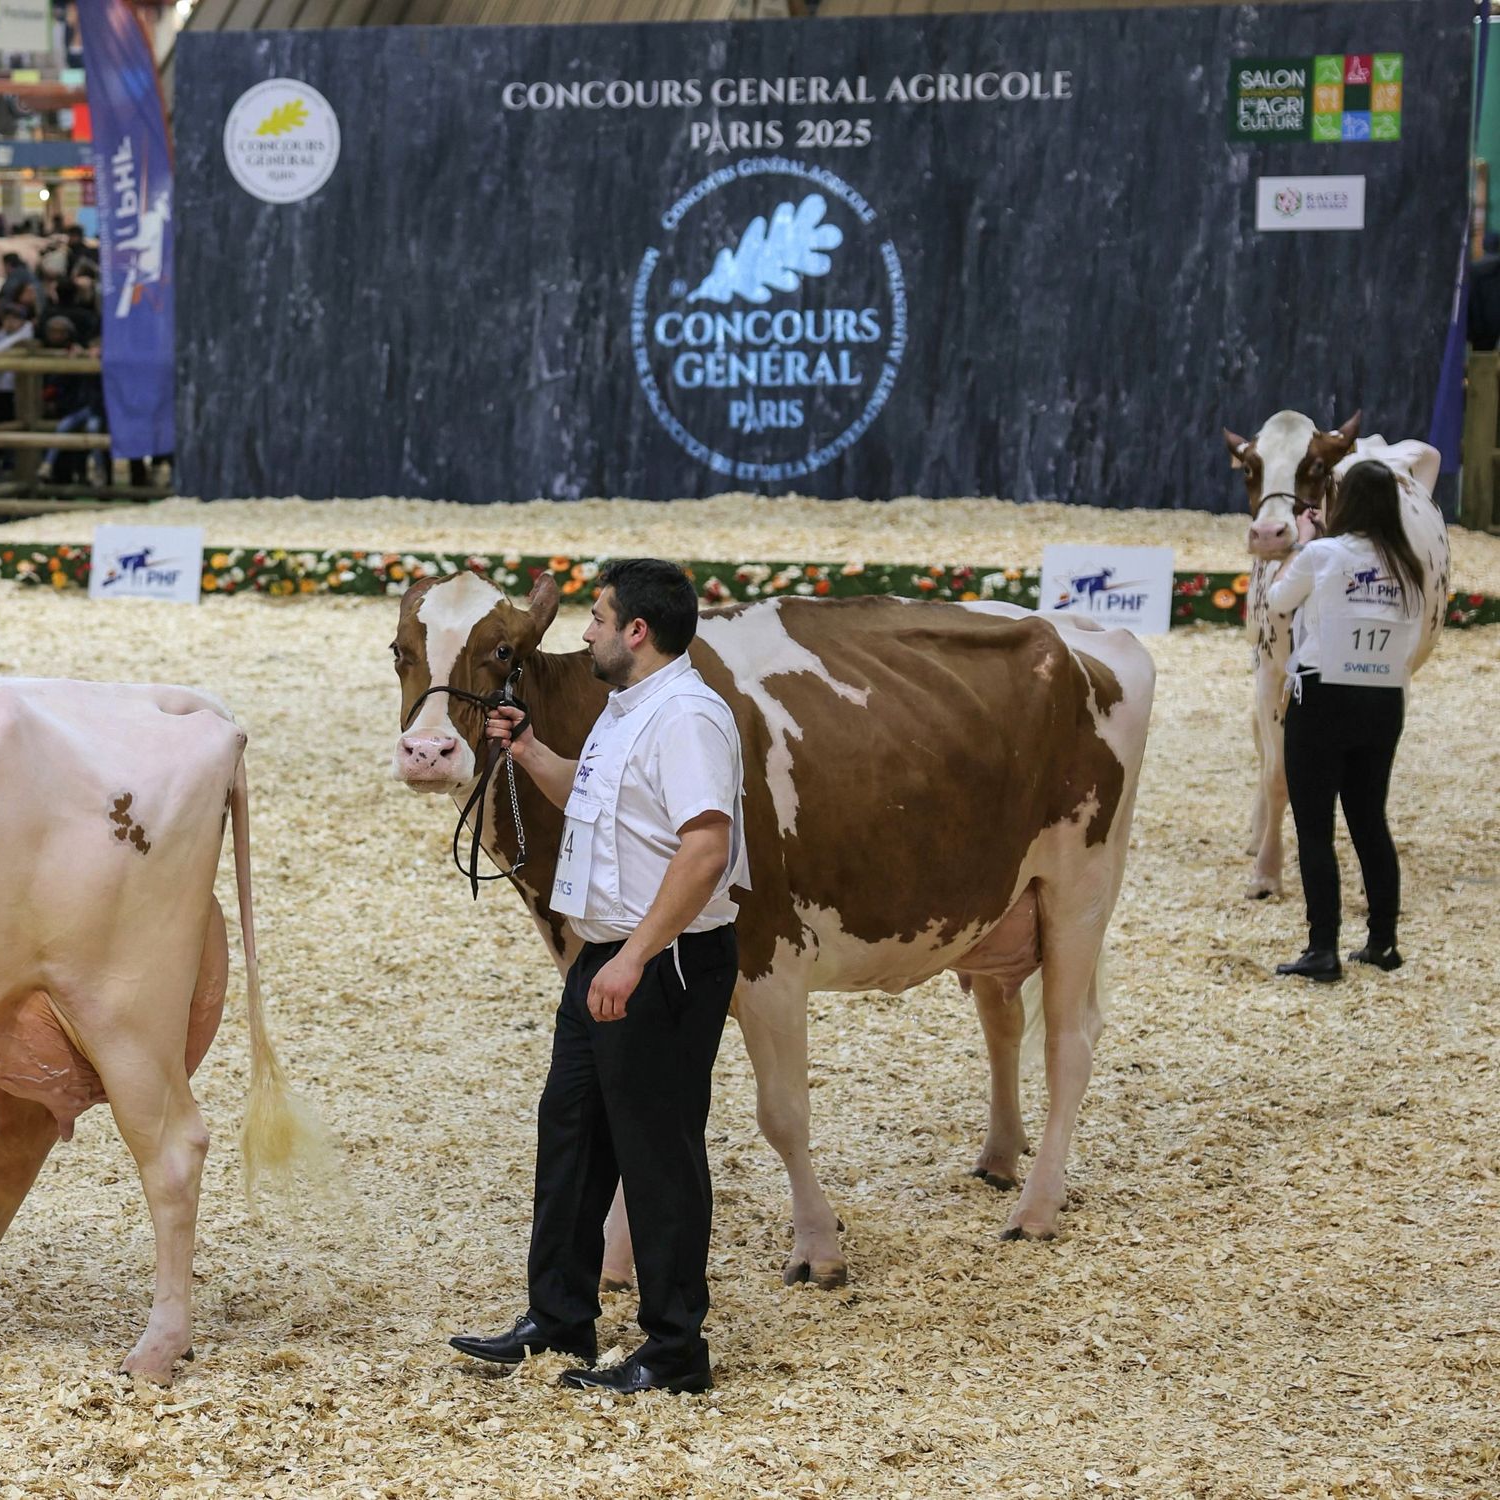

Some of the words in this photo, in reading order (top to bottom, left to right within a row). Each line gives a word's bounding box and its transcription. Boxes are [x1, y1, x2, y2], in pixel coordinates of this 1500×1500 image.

[502, 78, 702, 111] CONCOURS
[710, 75, 876, 107] GENERAL
[884, 70, 1073, 102] AGRICOLE
[1239, 69, 1306, 89] SALON
[690, 107, 784, 156] PARIS
[795, 118, 872, 149] 2025
[1238, 113, 1303, 131] CULTURE
[654, 308, 881, 347] CONCOURS
[673, 343, 862, 388] GÉNÉRAL
[729, 387, 805, 434] PARIS
[1106, 593, 1148, 611] PHF
[1352, 628, 1391, 652] 117
[1344, 662, 1390, 675] SYNETICS
